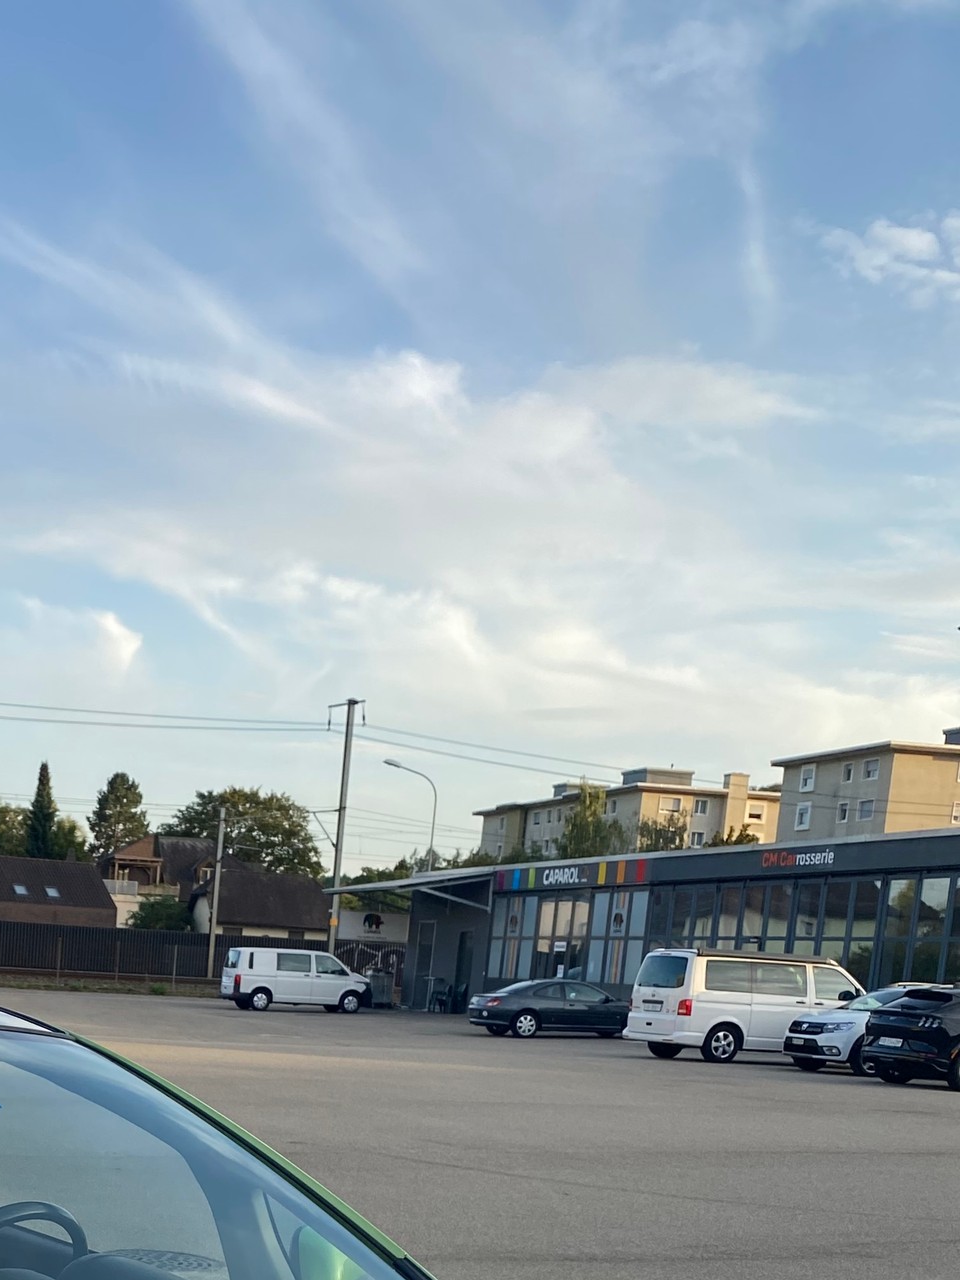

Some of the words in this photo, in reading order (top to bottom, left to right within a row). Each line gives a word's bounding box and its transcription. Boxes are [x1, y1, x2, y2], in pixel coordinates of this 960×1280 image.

[762, 852, 778, 867] CM
[780, 848, 835, 866] Carrosserie
[543, 866, 579, 885] CAPAROL
